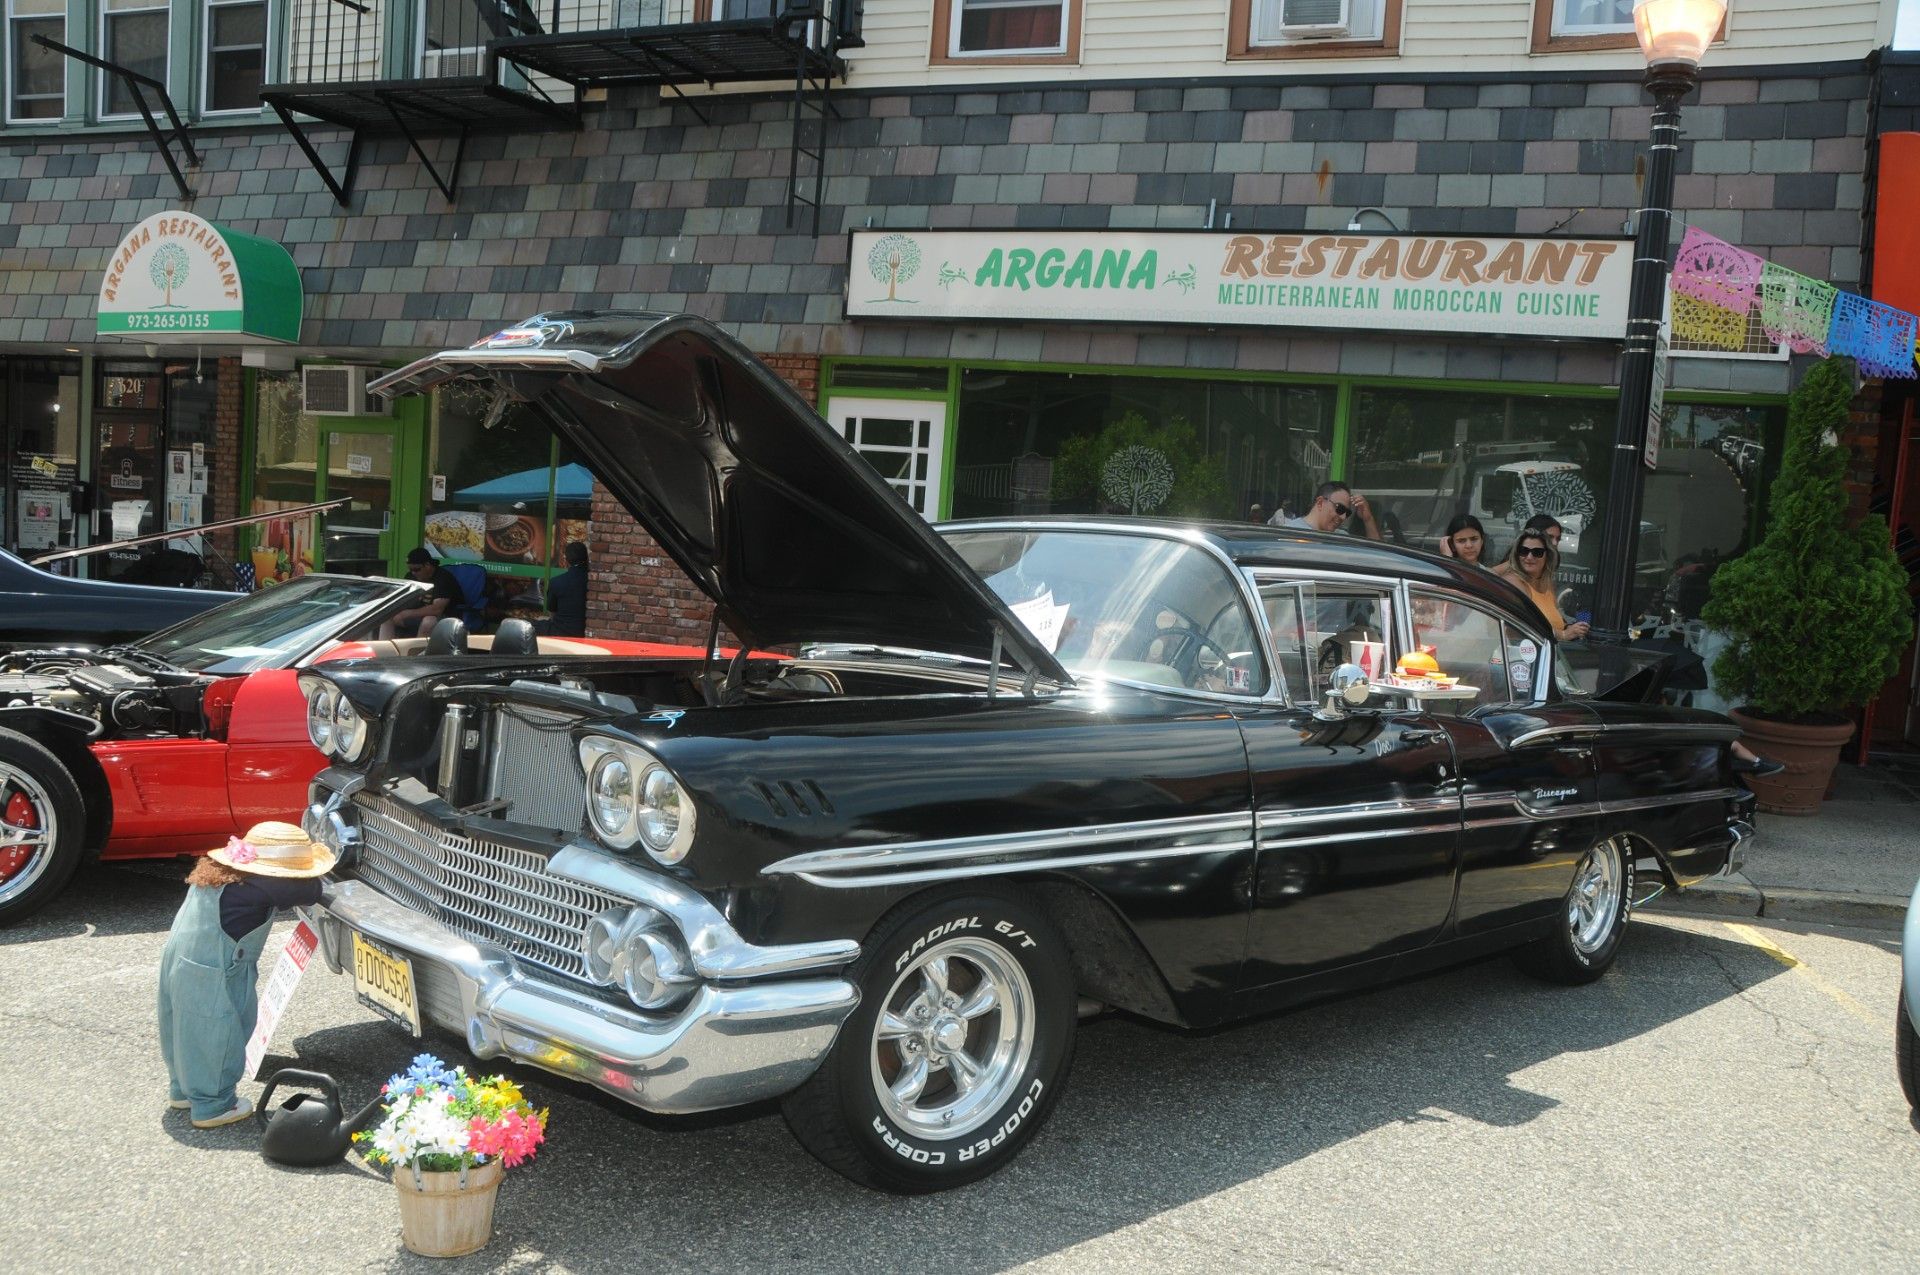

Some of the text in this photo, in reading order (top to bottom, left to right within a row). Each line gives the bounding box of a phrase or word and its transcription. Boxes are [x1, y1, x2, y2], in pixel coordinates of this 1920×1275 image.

[104, 217, 238, 302] ARGANA RESTAURANT
[973, 235, 1618, 292] ARGANA RESTAURANT
[127, 314, 210, 329] 973-265-0155
[1217, 283, 1601, 318] MEDITERRANEAN MOROCCAN CUISINE
[1621, 863, 1634, 923] COBRA
[895, 916, 1037, 972] RADIAL G/T
[365, 951, 412, 1009] DOCS58
[871, 1078, 1044, 1165] COOPER COBRA
